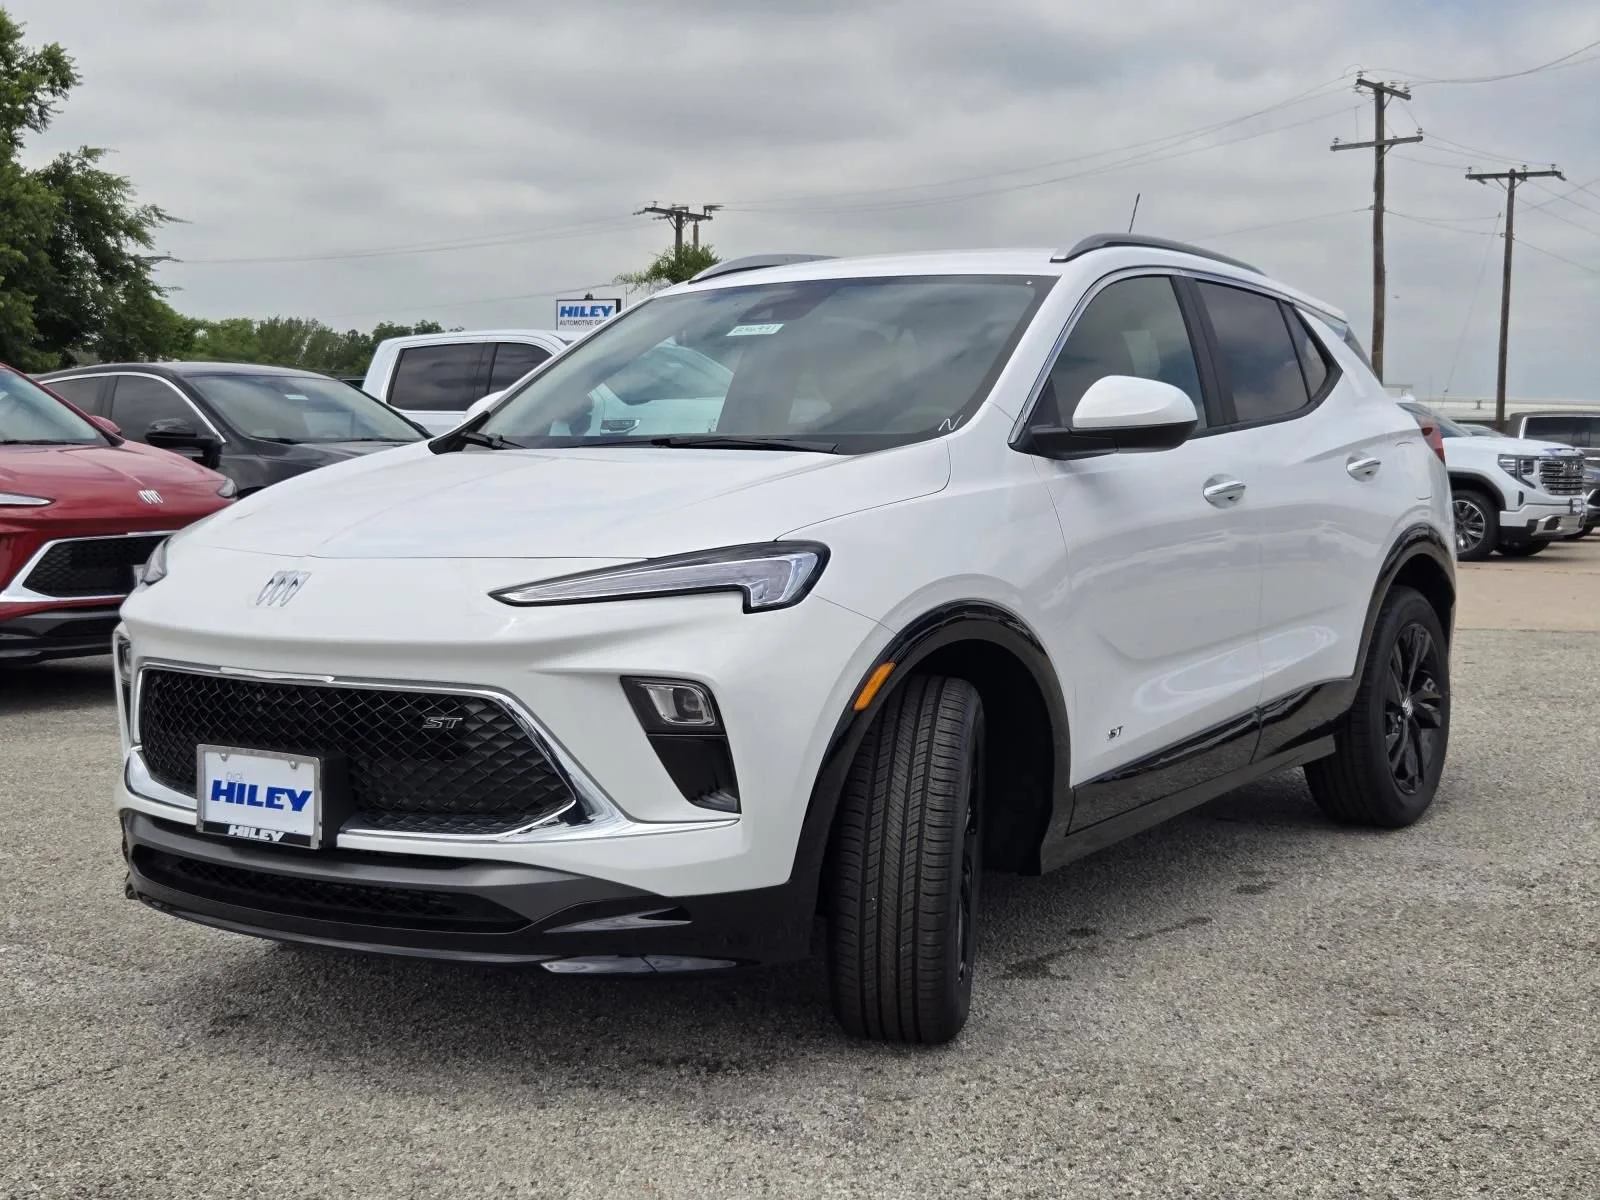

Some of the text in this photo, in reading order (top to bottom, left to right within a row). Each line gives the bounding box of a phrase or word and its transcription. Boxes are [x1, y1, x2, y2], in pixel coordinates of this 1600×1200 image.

[560, 305, 614, 318] HILEY
[422, 716, 463, 729] ST
[1107, 725, 1124, 740] ST
[210, 779, 313, 812] HILEY
[228, 824, 285, 842] HILEY
